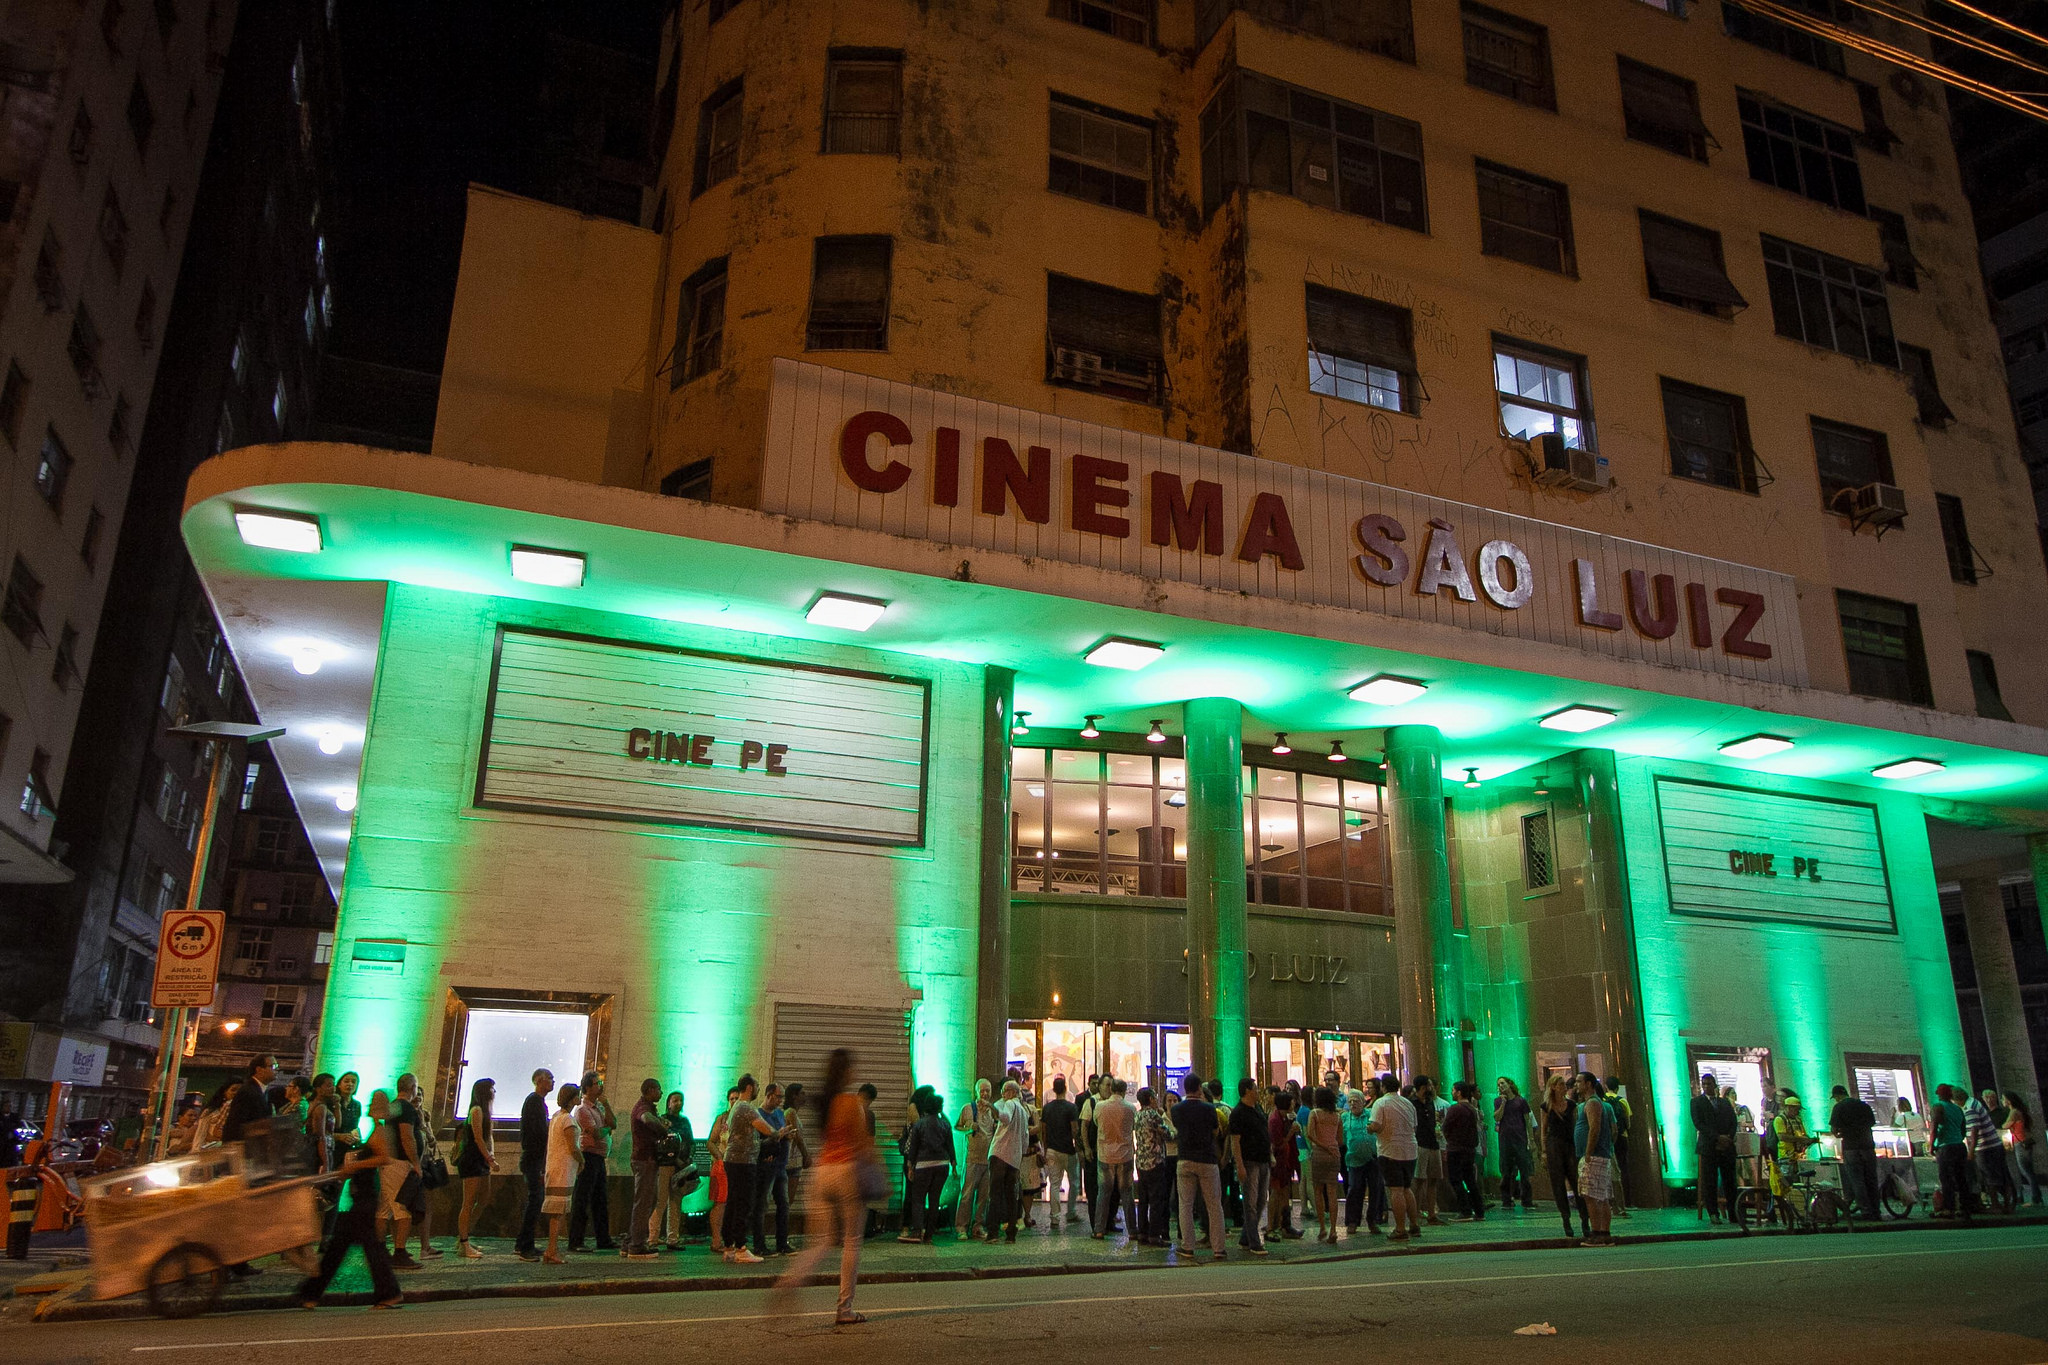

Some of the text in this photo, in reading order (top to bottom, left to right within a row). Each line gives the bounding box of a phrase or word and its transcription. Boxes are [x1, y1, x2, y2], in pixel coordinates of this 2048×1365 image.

[839, 410, 1305, 572] CINEMA
[1355, 513, 1534, 610] SÃO
[1573, 557, 1773, 660] LUIZ
[627, 727, 789, 774] CINE PE
[1729, 849, 1822, 882] CINE PE
[1270, 952, 1349, 985] LUIZ
